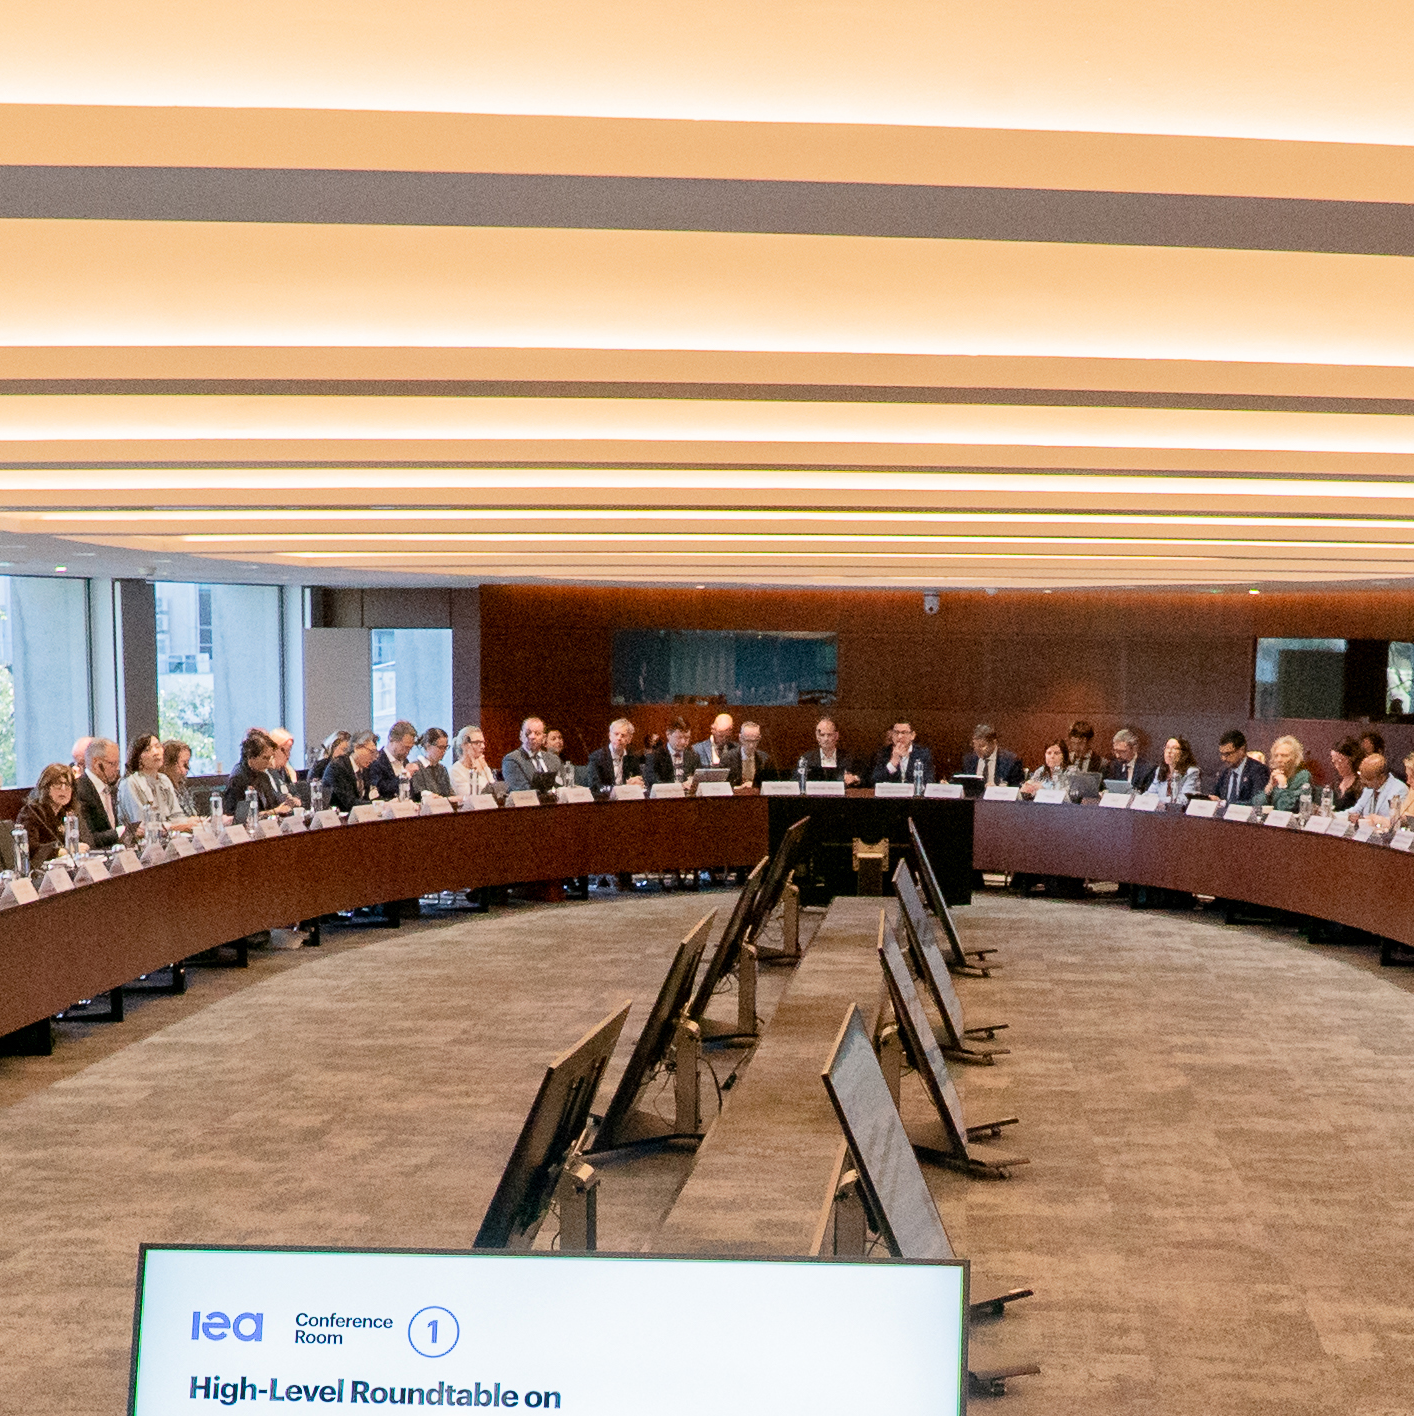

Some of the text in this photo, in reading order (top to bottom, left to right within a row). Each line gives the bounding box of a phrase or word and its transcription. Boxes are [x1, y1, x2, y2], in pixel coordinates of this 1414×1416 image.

[295, 1311, 394, 1330] Conference
[426, 1319, 440, 1344] 1
[294, 1329, 343, 1346] Room
[189, 1374, 562, 1409] High-Level Roundtable on
